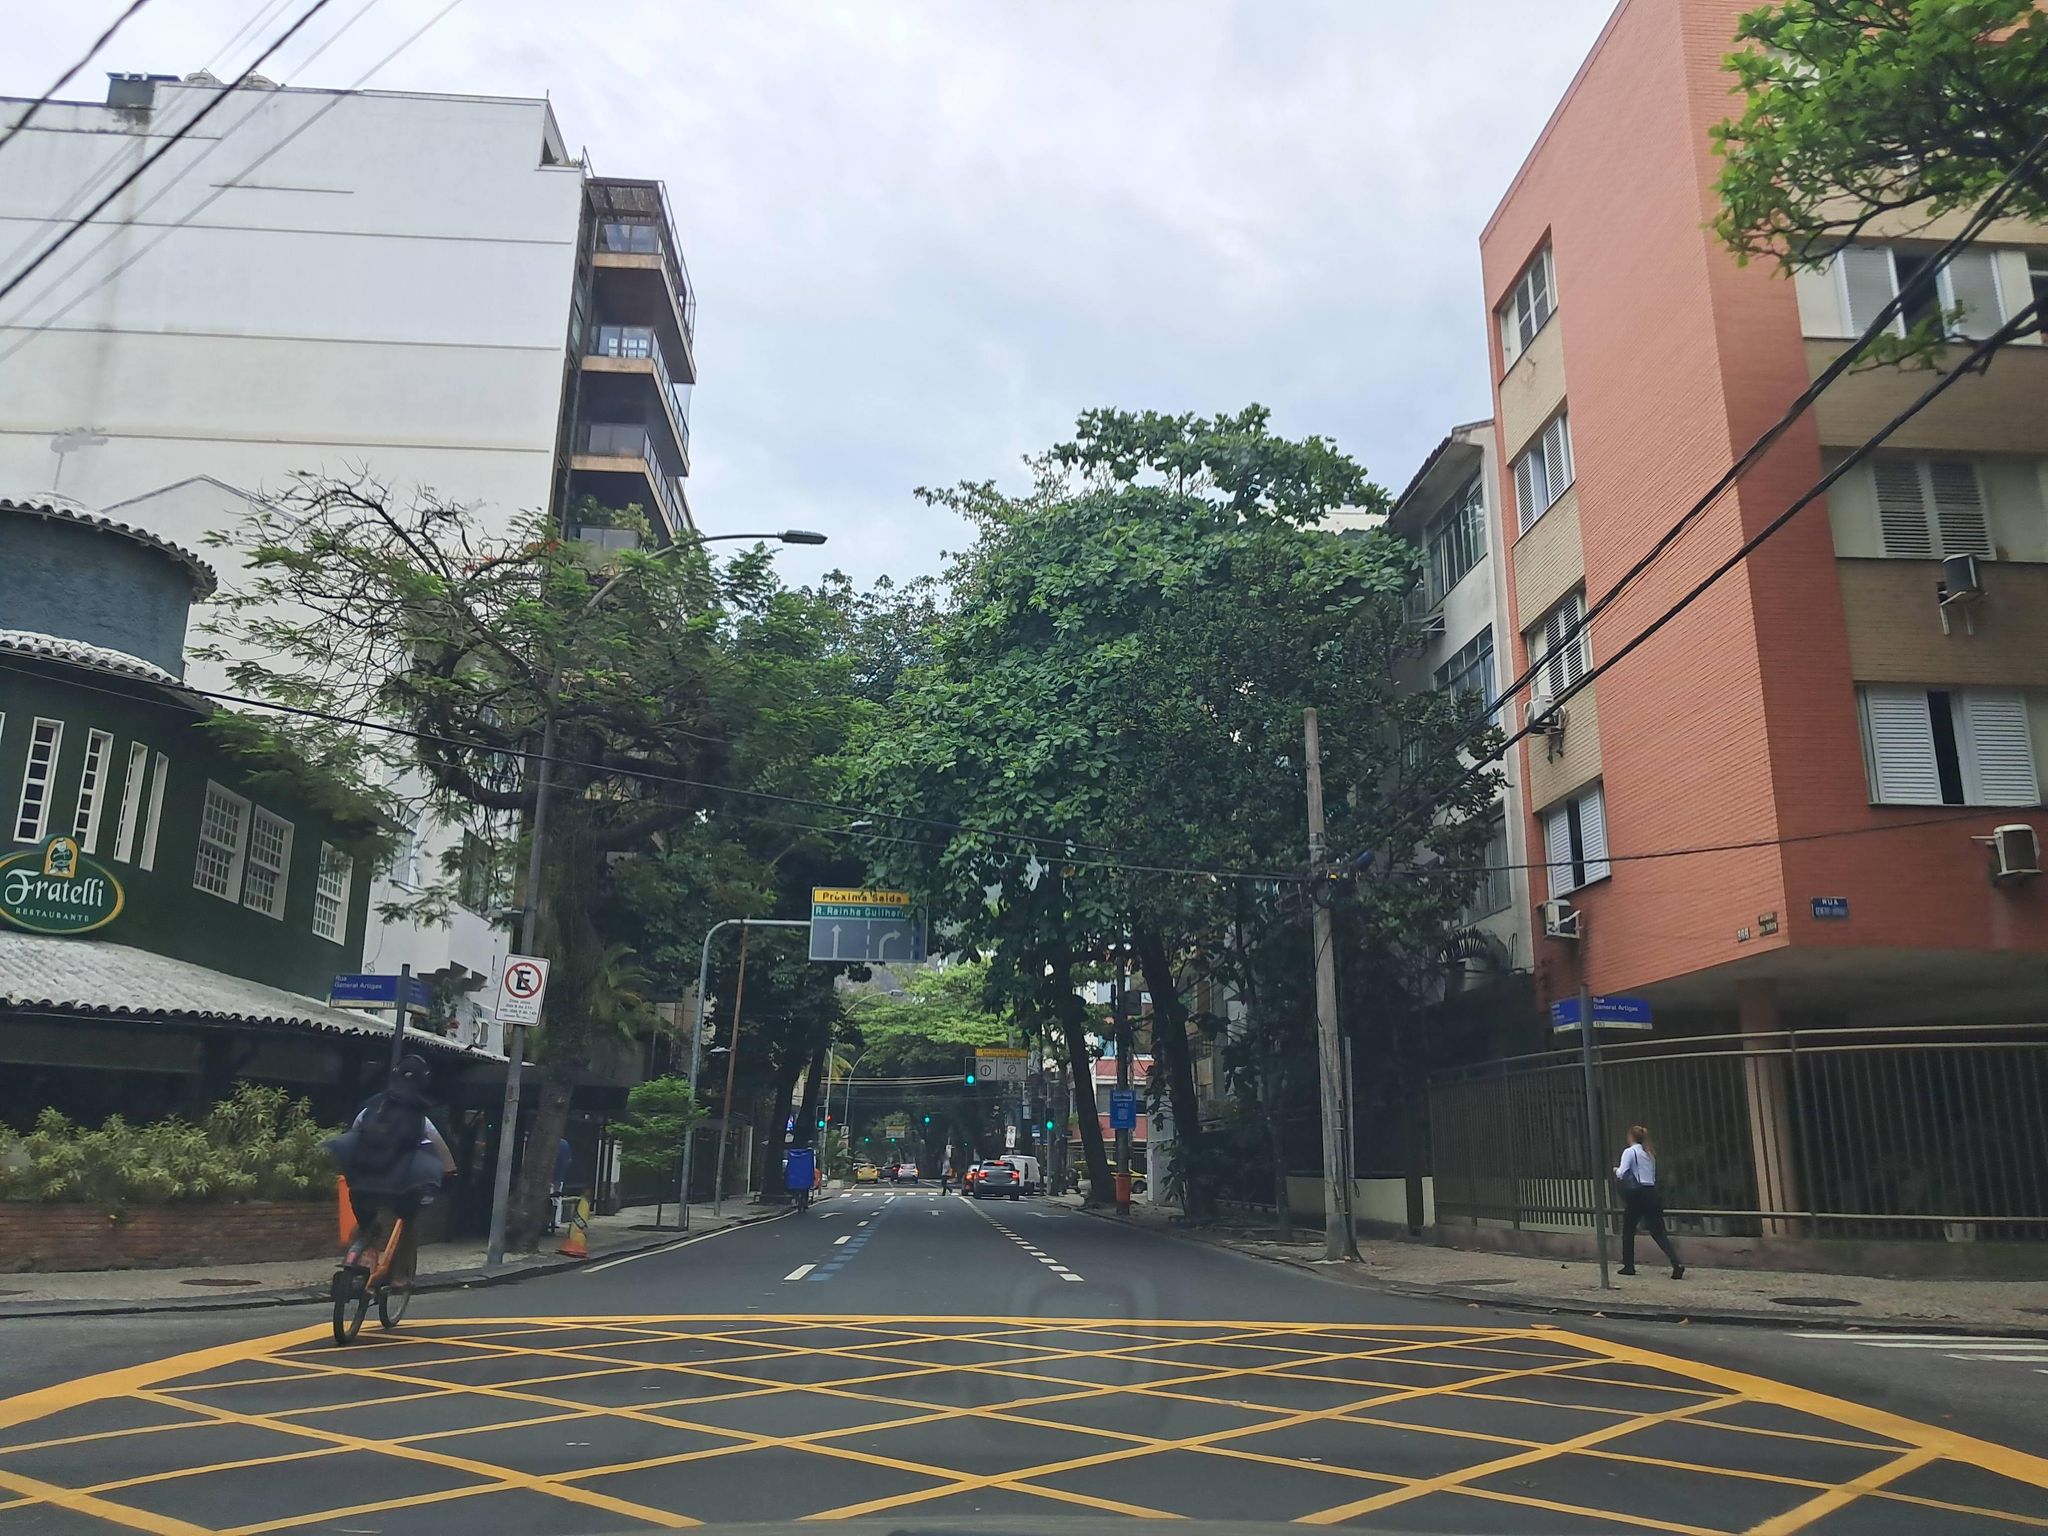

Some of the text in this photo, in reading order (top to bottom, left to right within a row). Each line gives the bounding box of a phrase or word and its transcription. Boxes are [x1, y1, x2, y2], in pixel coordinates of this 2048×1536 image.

[4, 868, 105, 907] Fratelli
[822, 891, 868, 902] Próxima
[15, 907, 90, 923] RESTAURANTE
[827, 906, 861, 917] Rainha
[359, 983, 383, 991] Artigas
[1618, 1004, 1639, 1013] Artigas
